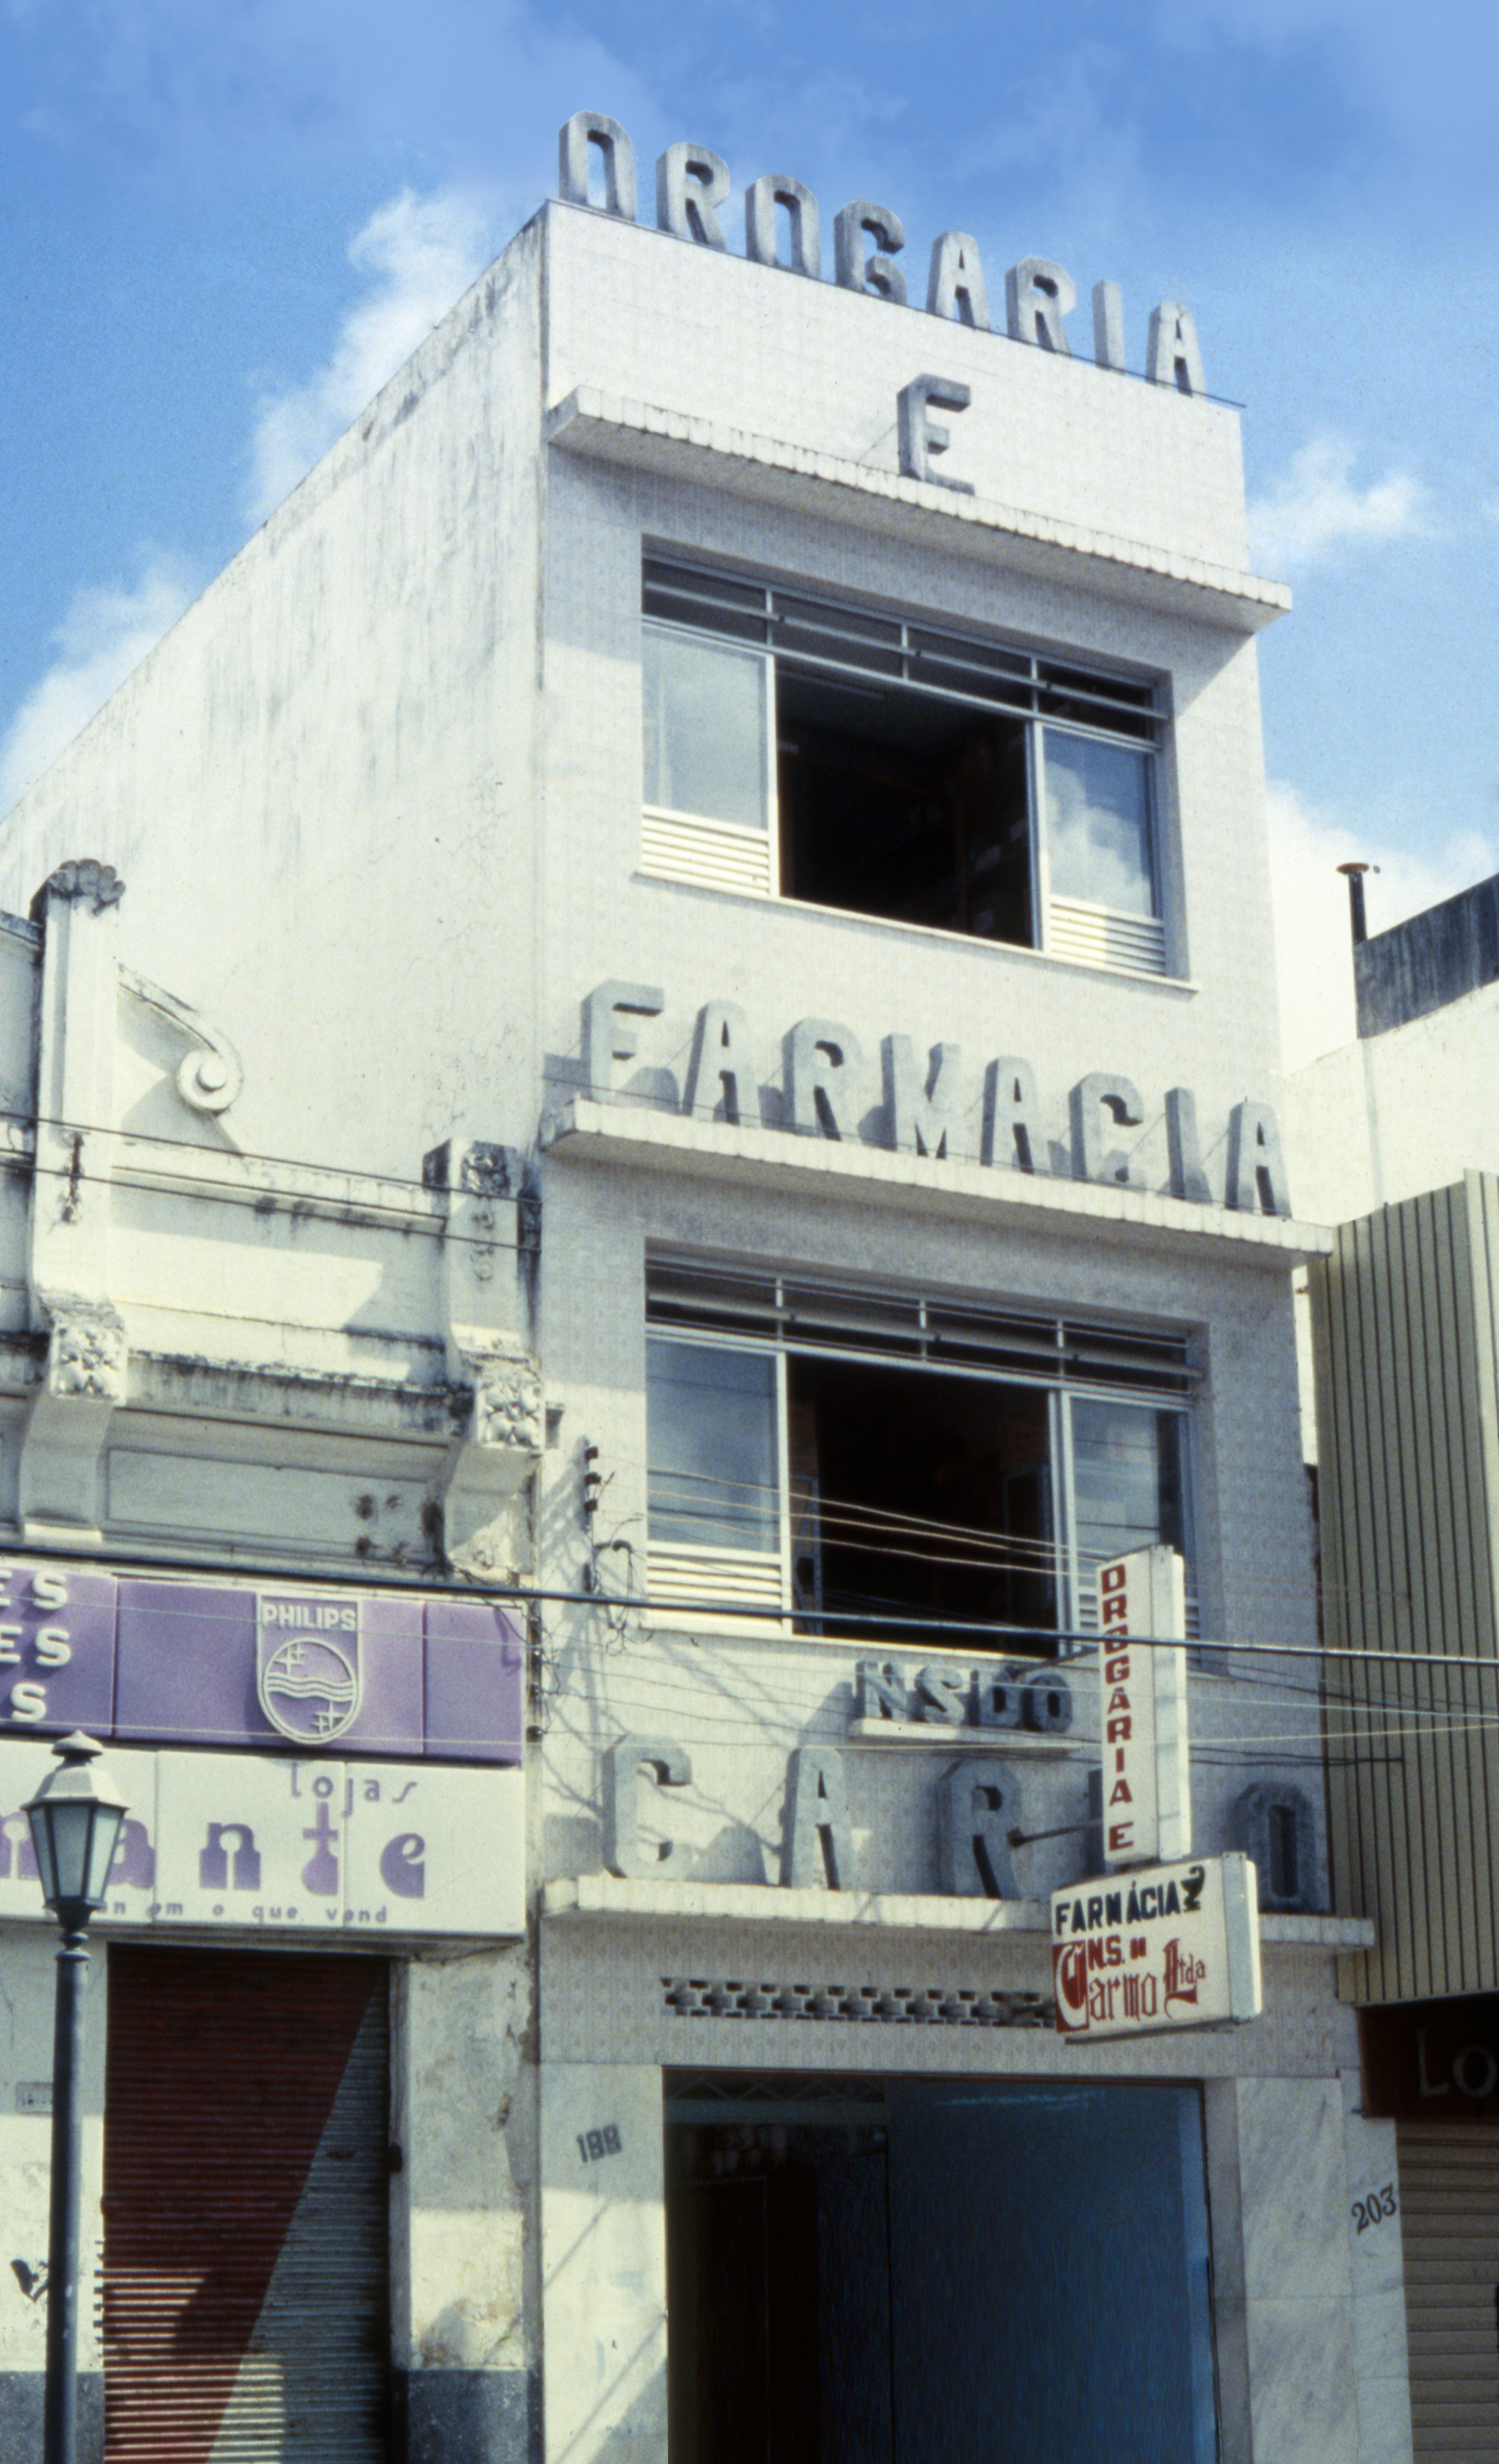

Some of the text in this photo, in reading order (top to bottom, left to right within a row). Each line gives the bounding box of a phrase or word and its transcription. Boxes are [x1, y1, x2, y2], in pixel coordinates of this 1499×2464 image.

[558, 109, 1205, 397] DROGARIA
[898, 373, 976, 495] E
[581, 979, 1293, 1218] FARMACIA
[261, 1603, 357, 1631] PHILIPS
[1101, 1564, 1133, 1851] DROGARIA E
[602, 1732, 1319, 1917] CARO
[1056, 1880, 1181, 1936] FARMÁCIA
[1053, 1941, 1158, 2032] Carmo
[1351, 2185, 1397, 2233] 203
